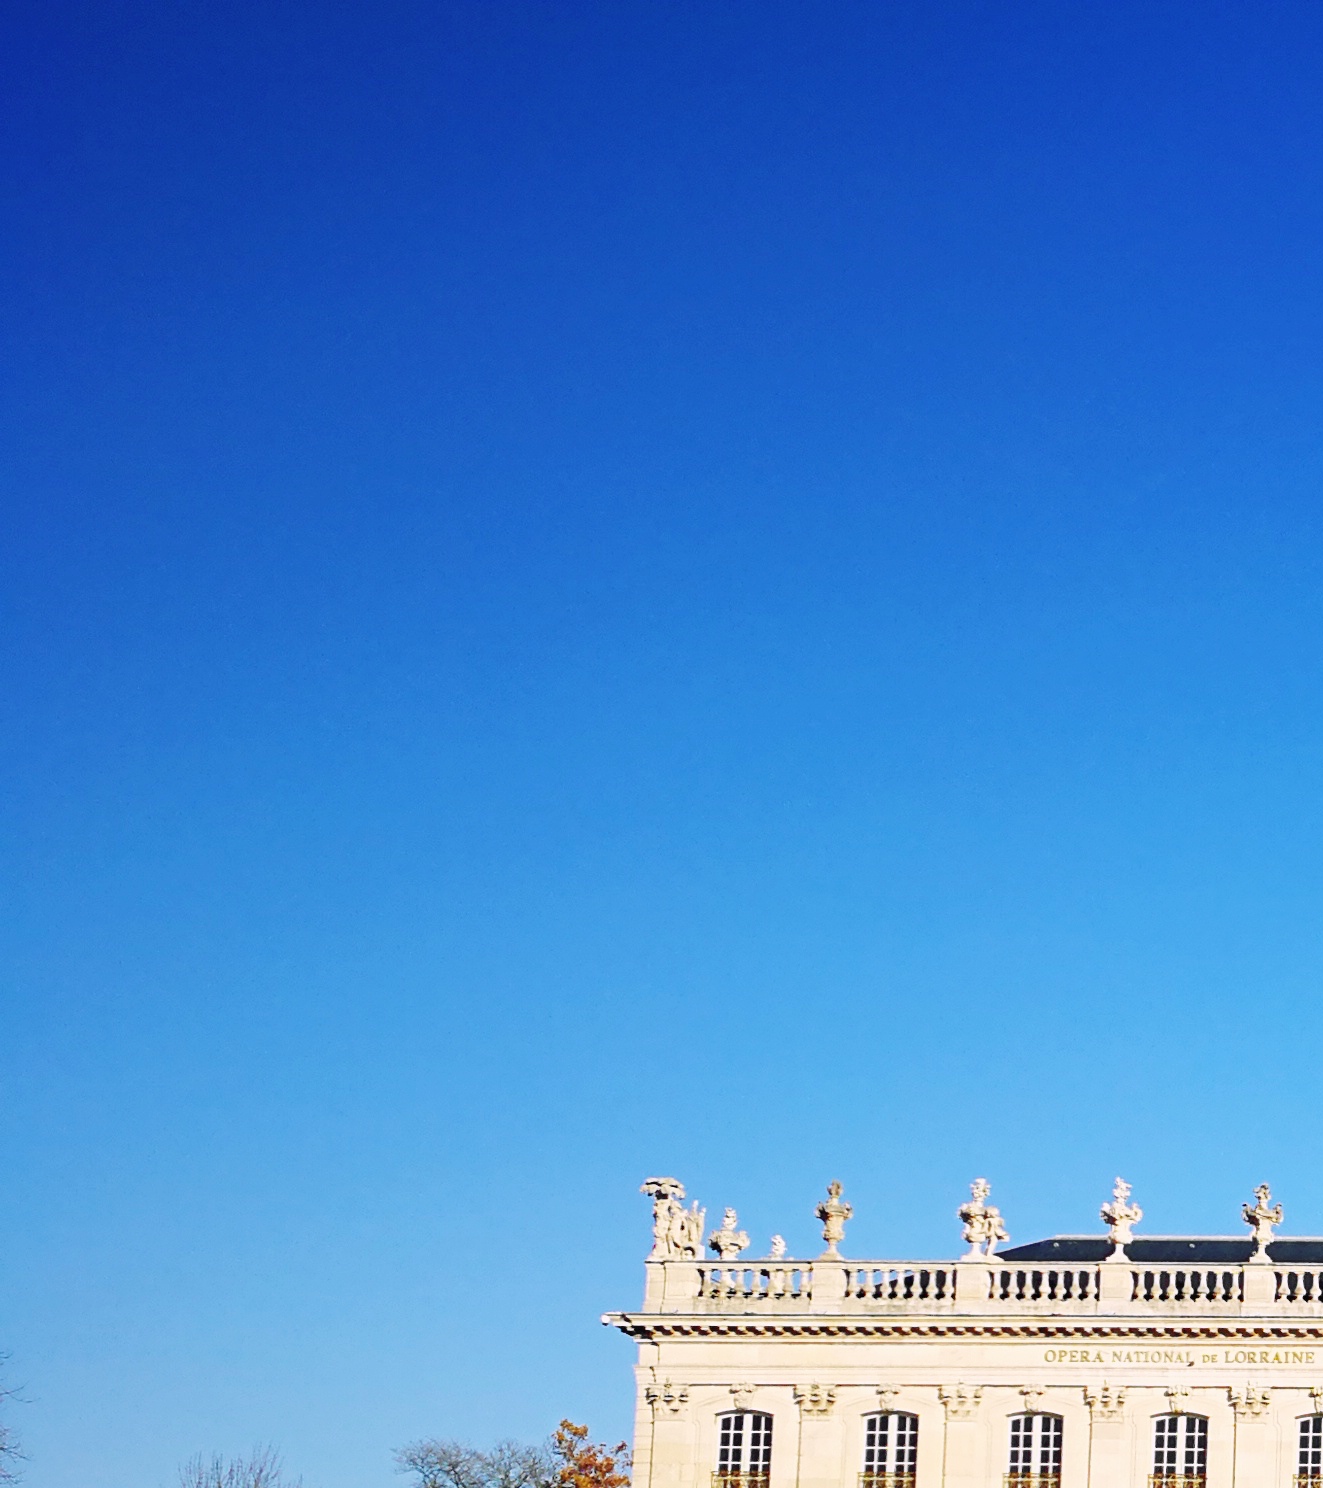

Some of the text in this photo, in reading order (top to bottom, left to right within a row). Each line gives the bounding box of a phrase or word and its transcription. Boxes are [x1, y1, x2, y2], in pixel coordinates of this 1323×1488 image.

[1044, 1349, 1105, 1363] OPERA
[1111, 1350, 1194, 1364] NATIONAL
[1223, 1350, 1316, 1364] LORRAINE
